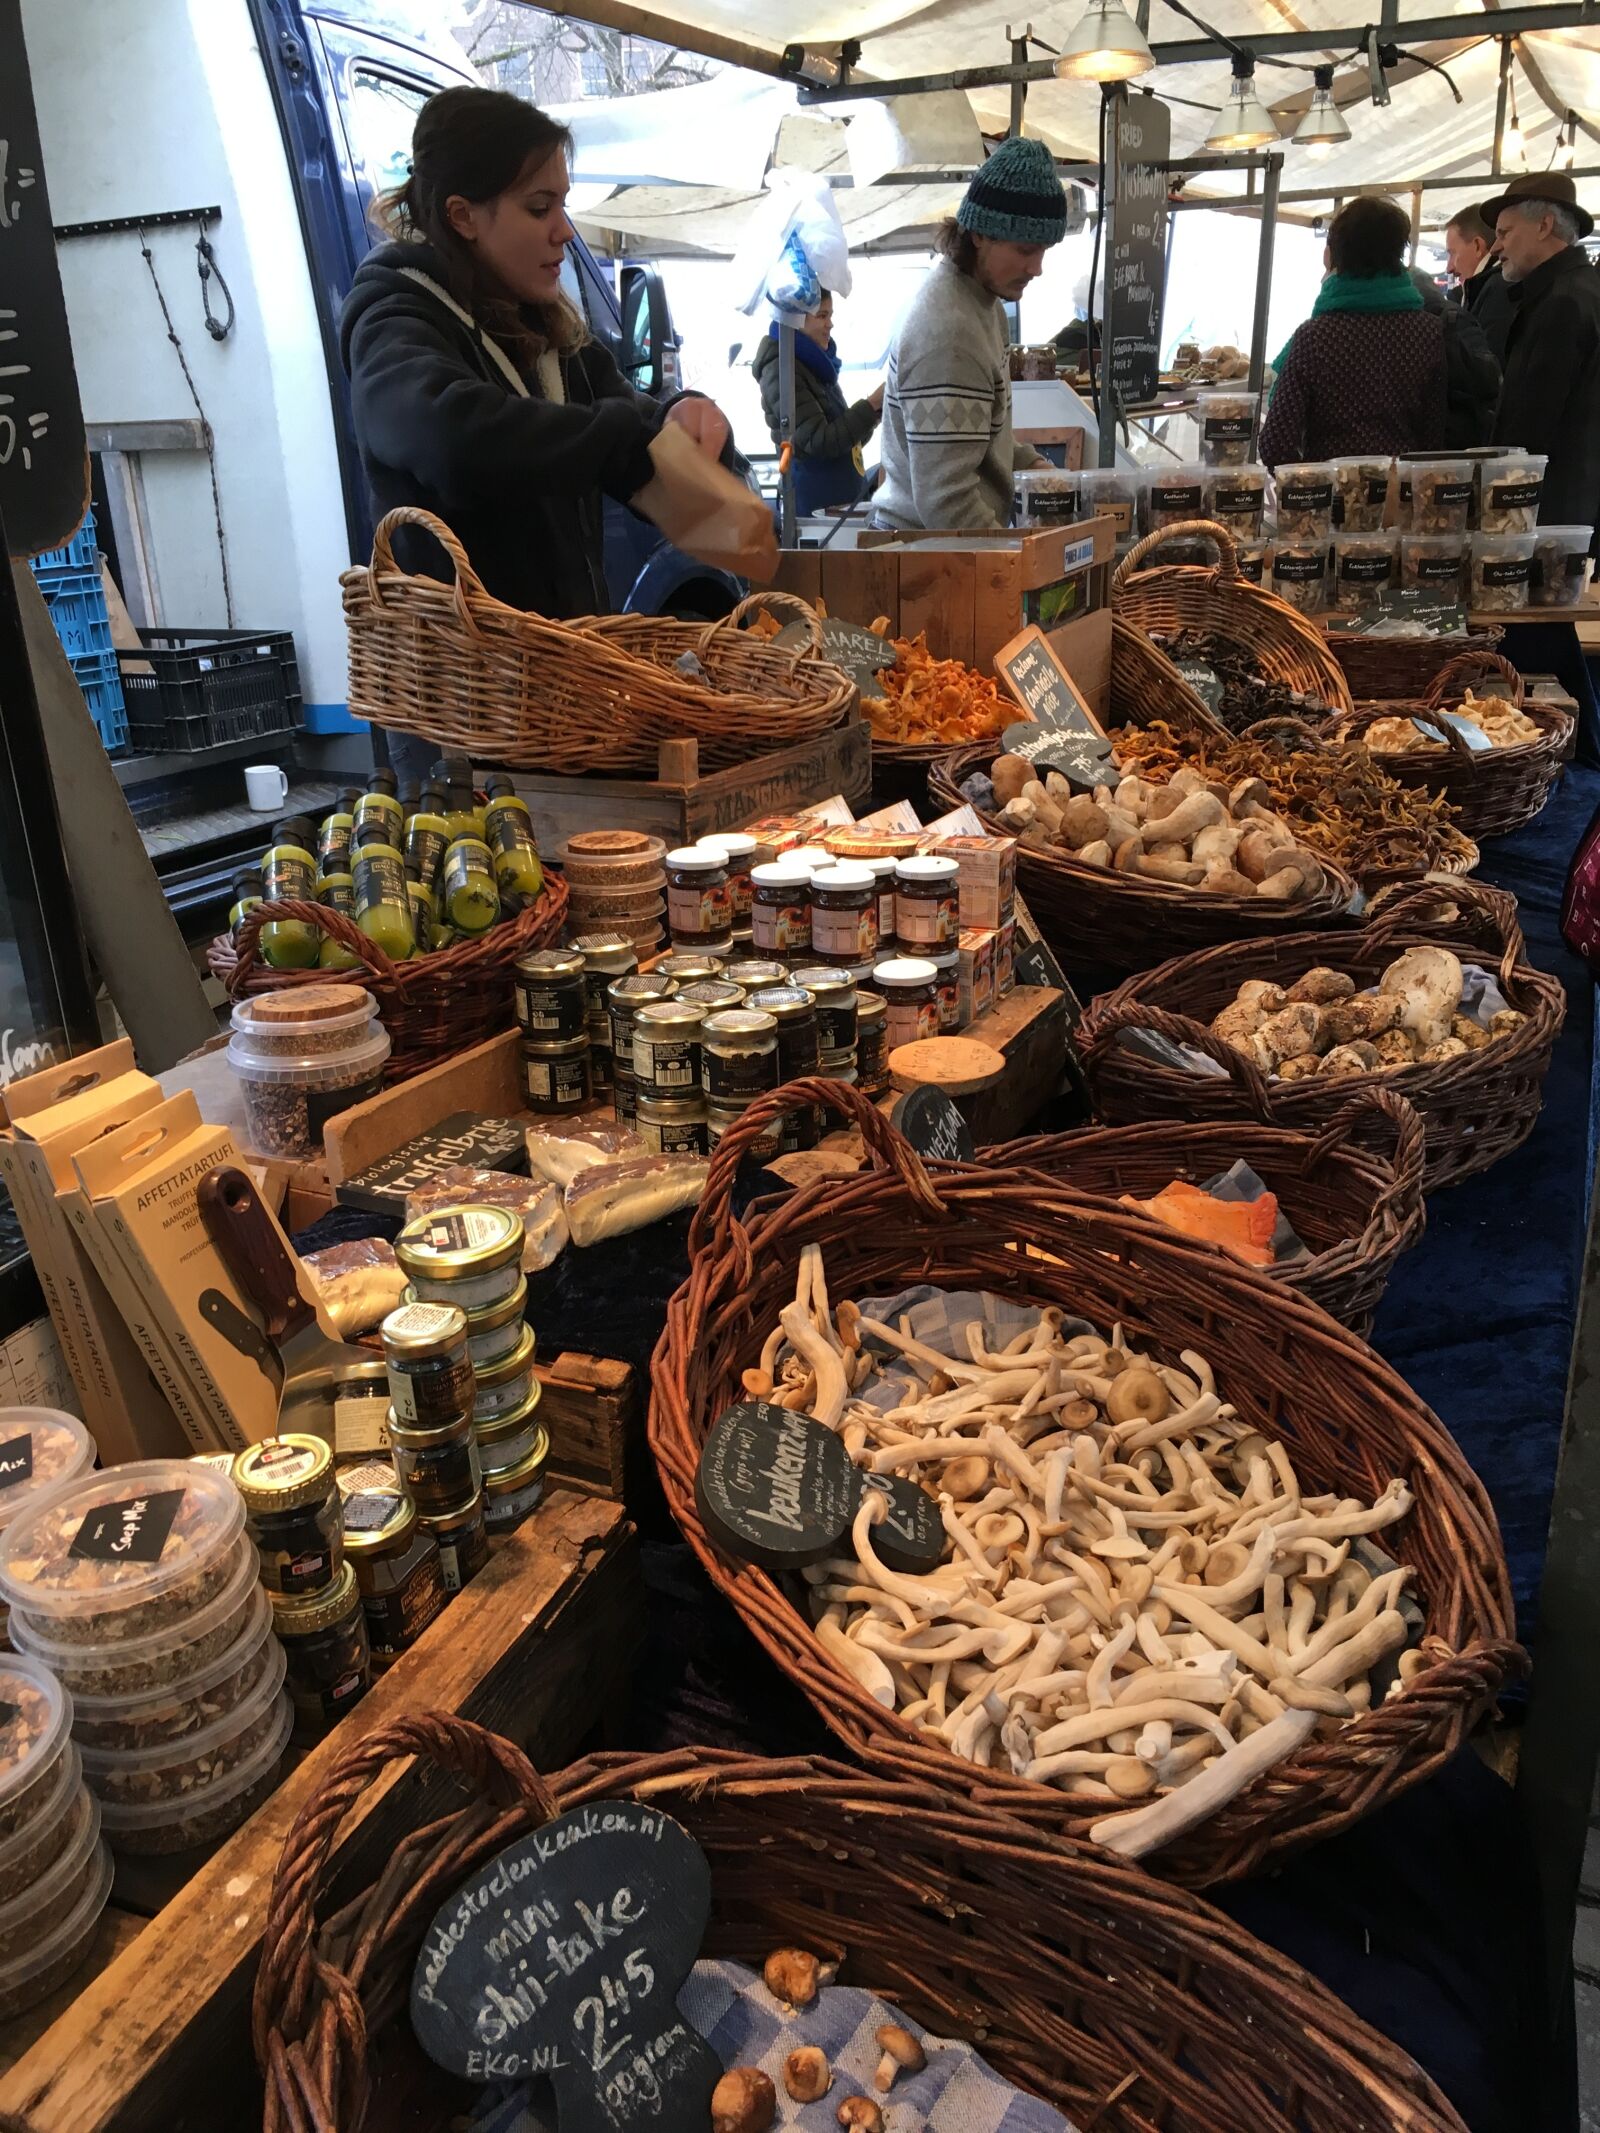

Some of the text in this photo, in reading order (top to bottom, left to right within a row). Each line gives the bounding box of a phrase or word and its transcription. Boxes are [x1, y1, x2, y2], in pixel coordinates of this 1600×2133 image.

[1121, 121, 1143, 149] FRIED
[136, 1142, 235, 1212] AFFETTATARTUFI
[350, 1136, 437, 1186] biologische
[371, 1118, 509, 1195] truffelbrie
[42, 1272, 88, 1392] AFFETTATARTUFI
[66, 1276, 112, 1398] AFFETTATARTUFI
[135, 1323, 204, 1441] AFFETTATARTUFI
[111, 1500, 149, 1552] Soep Mix
[484, 1899, 561, 1963] mini
